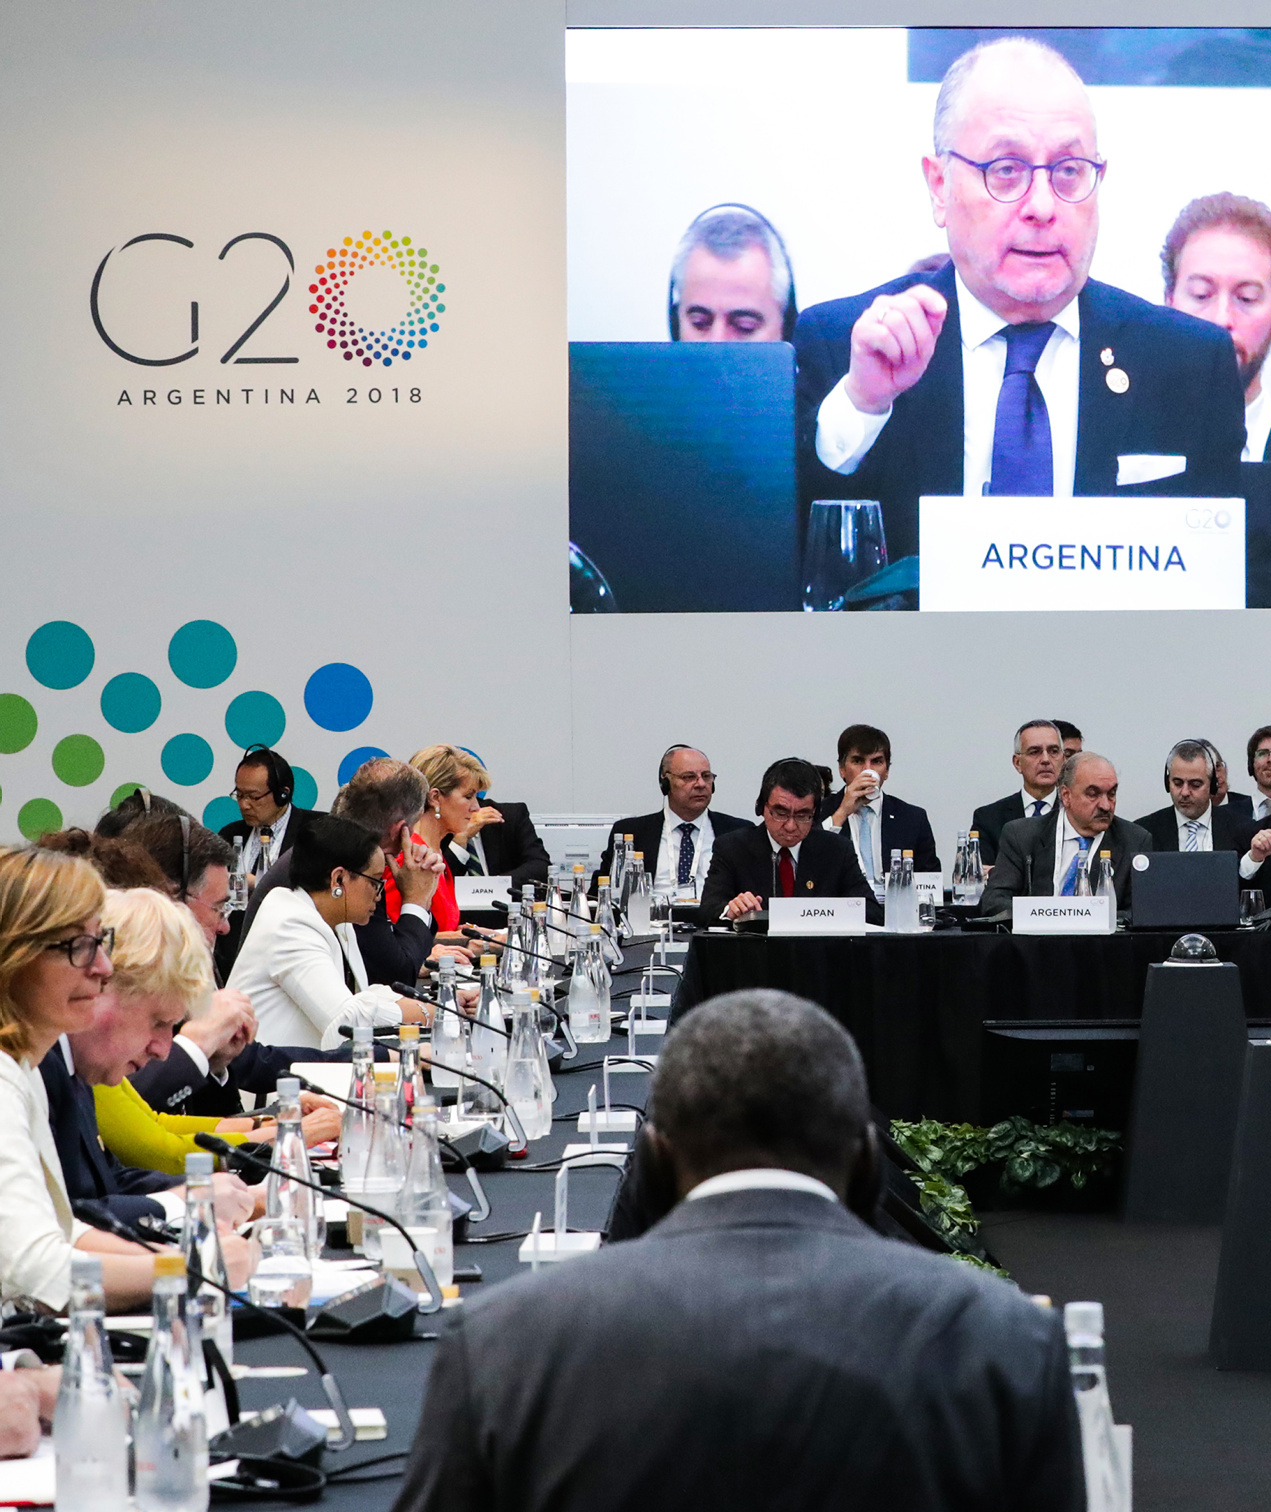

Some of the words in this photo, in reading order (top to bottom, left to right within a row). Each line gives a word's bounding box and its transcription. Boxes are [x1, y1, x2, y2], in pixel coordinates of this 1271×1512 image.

[90, 230, 446, 367] G20
[117, 388, 321, 406] ARGENTINA
[346, 387, 422, 404] 2018
[981, 543, 1187, 572] ARGENTINA
[800, 909, 835, 917] JAPAN
[1030, 908, 1091, 917] ARGENTINA
